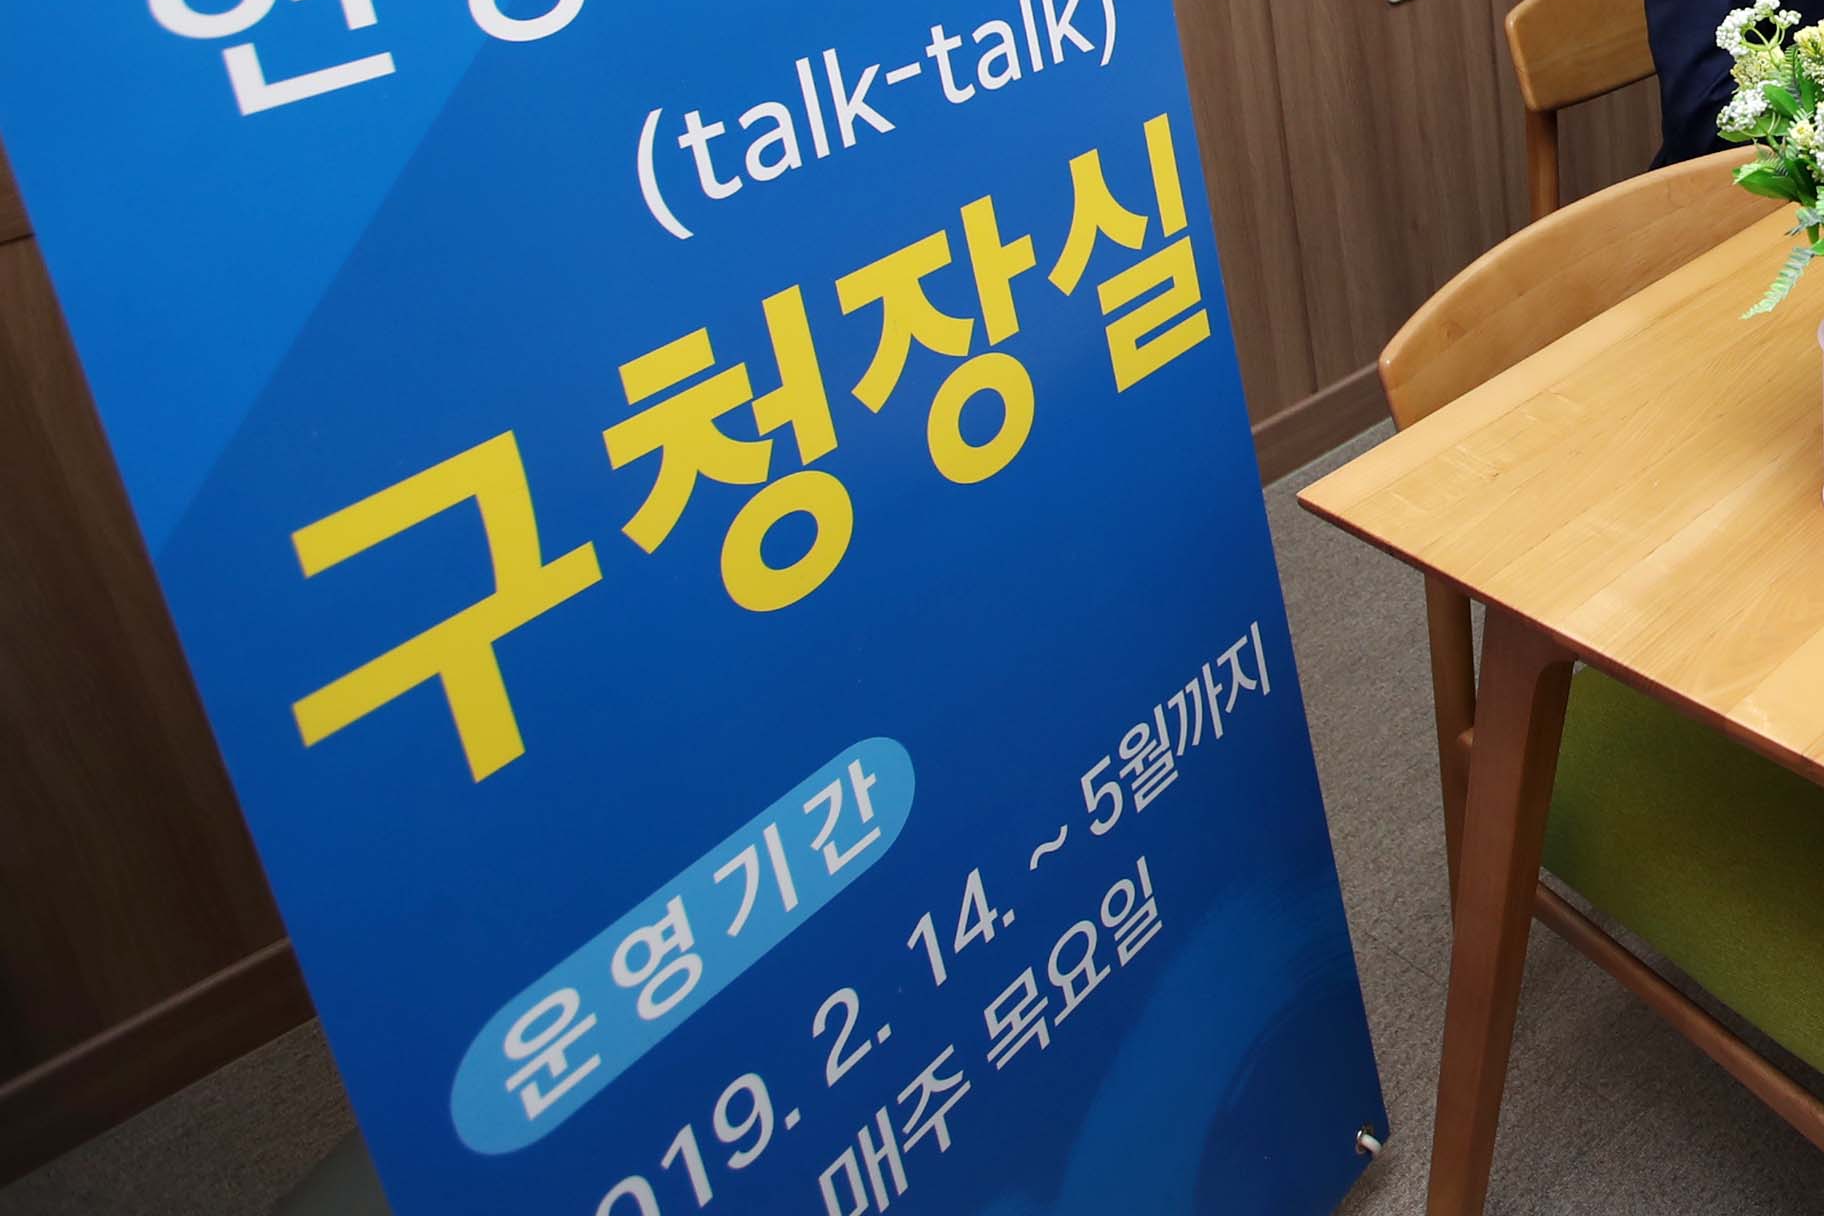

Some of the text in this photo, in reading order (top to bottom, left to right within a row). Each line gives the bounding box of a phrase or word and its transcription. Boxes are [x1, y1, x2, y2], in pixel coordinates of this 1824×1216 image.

[293, 117, 1209, 782] 구청장실
[813, 988, 891, 1086] 2.
[908, 868, 1014, 987] 14.
[1081, 622, 1271, 836] 5월까지
[819, 856, 1162, 1216] 매주 목요일
